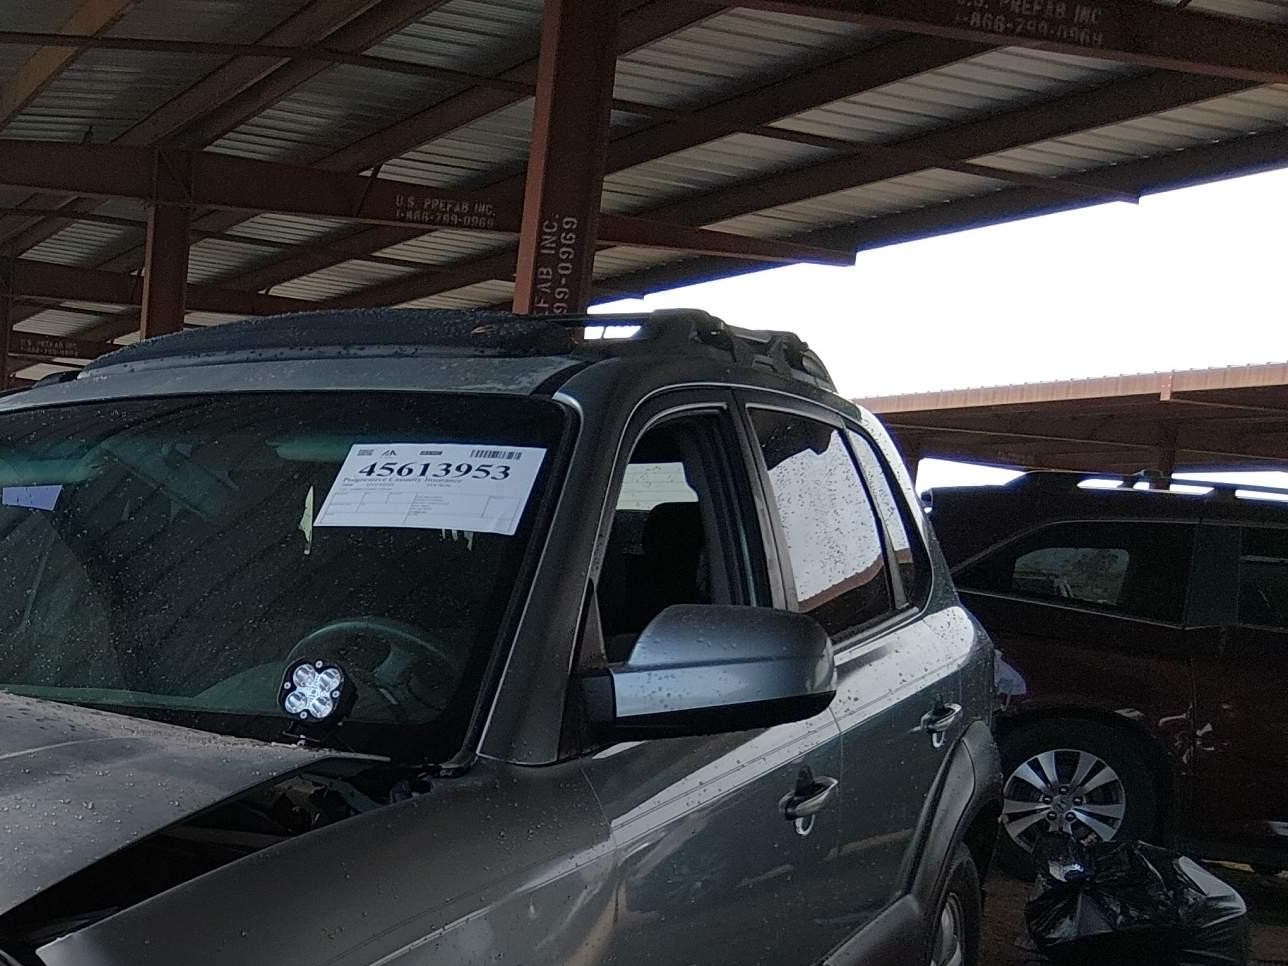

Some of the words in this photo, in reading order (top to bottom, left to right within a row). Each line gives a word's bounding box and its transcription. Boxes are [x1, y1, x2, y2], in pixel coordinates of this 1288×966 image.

[424, 198, 470, 213] PREFAB
[539, 214, 560, 254] INC.
[358, 461, 511, 481] 45613953
